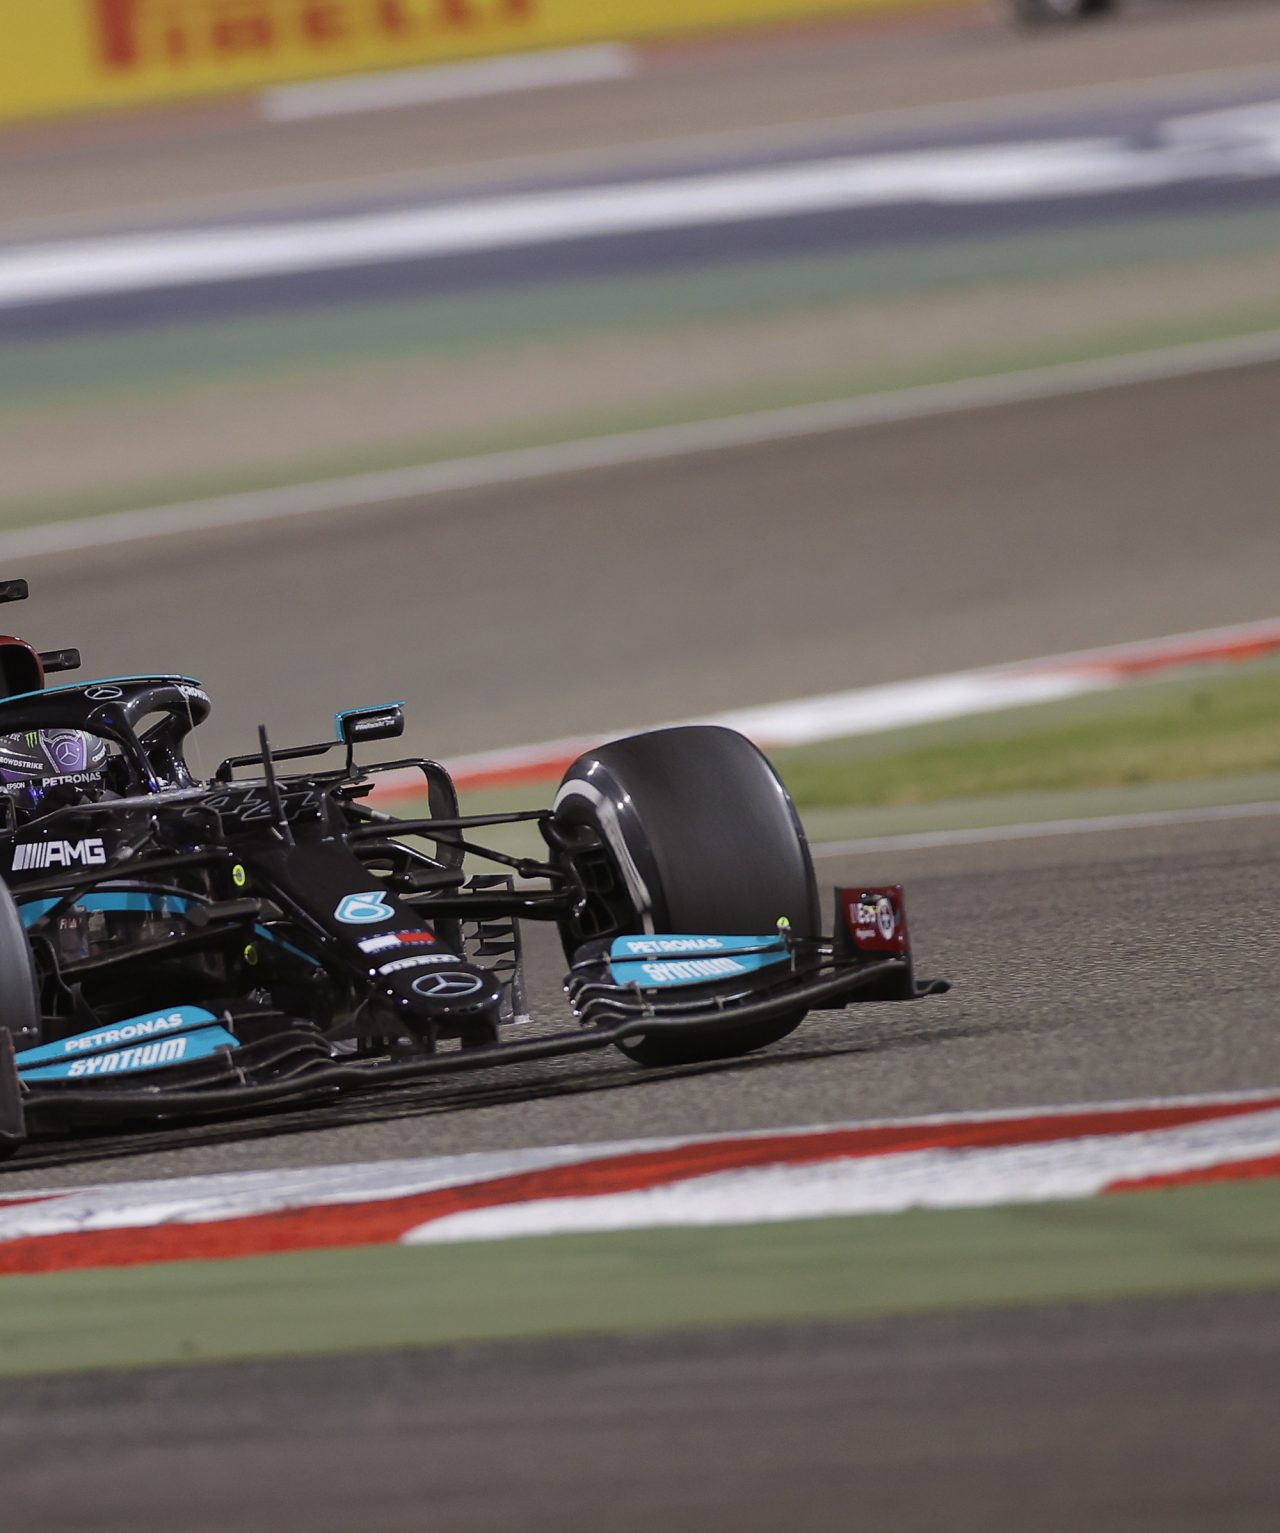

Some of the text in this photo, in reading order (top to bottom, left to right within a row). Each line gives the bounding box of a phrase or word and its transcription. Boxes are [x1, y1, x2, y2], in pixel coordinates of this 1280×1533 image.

[6, 782, 25, 790] EPSON
[42, 772, 101, 787] PETRONAS
[44, 838, 106, 868] AMG
[627, 938, 723, 953] PETRONAS
[641, 957, 746, 982] SYNTIUM
[65, 1013, 183, 1052] PETRONAS
[67, 1037, 187, 1078] SYNTIUM
